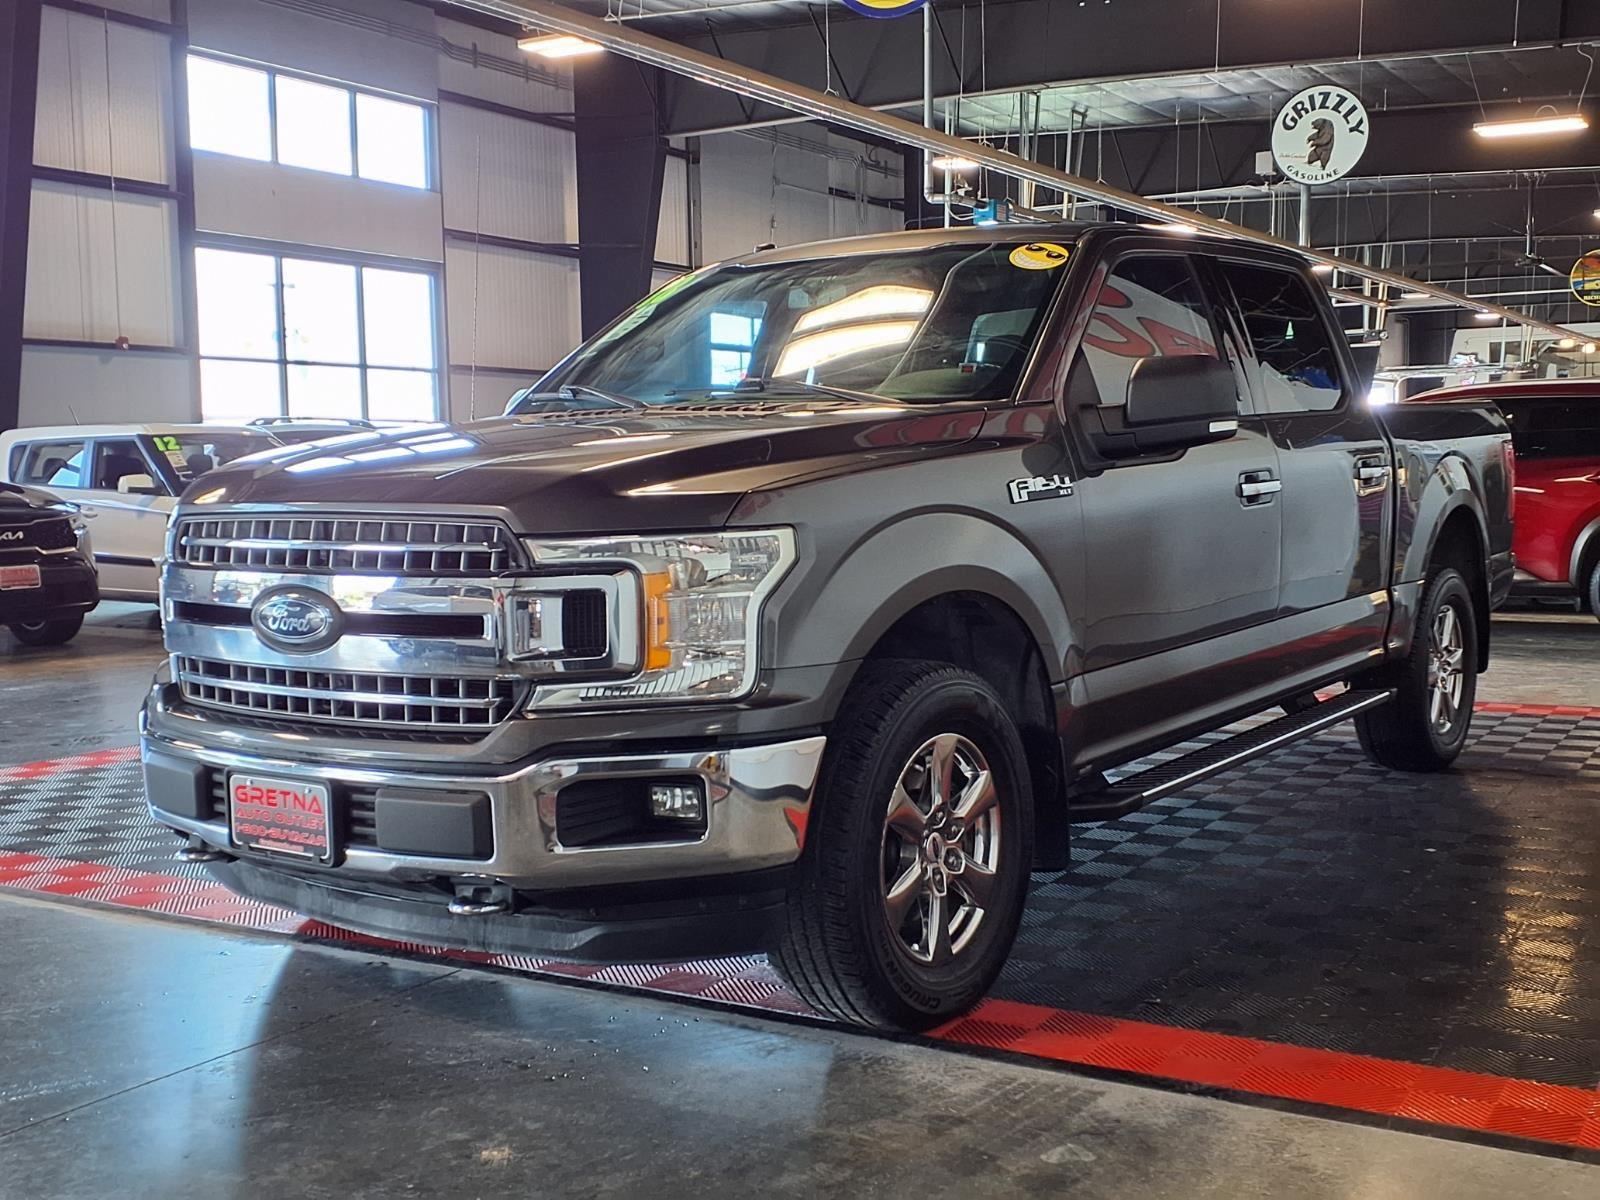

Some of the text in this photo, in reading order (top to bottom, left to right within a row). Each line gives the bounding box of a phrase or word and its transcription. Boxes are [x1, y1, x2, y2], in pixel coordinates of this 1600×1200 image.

[1282, 91, 1365, 135] GRIZZLY
[1286, 165, 1340, 181] GASOLINE
[153, 436, 182, 452] 12
[268, 604, 311, 632] Ford
[235, 785, 323, 815] GRETNA
[236, 808, 326, 831] AUTO OUTLET
